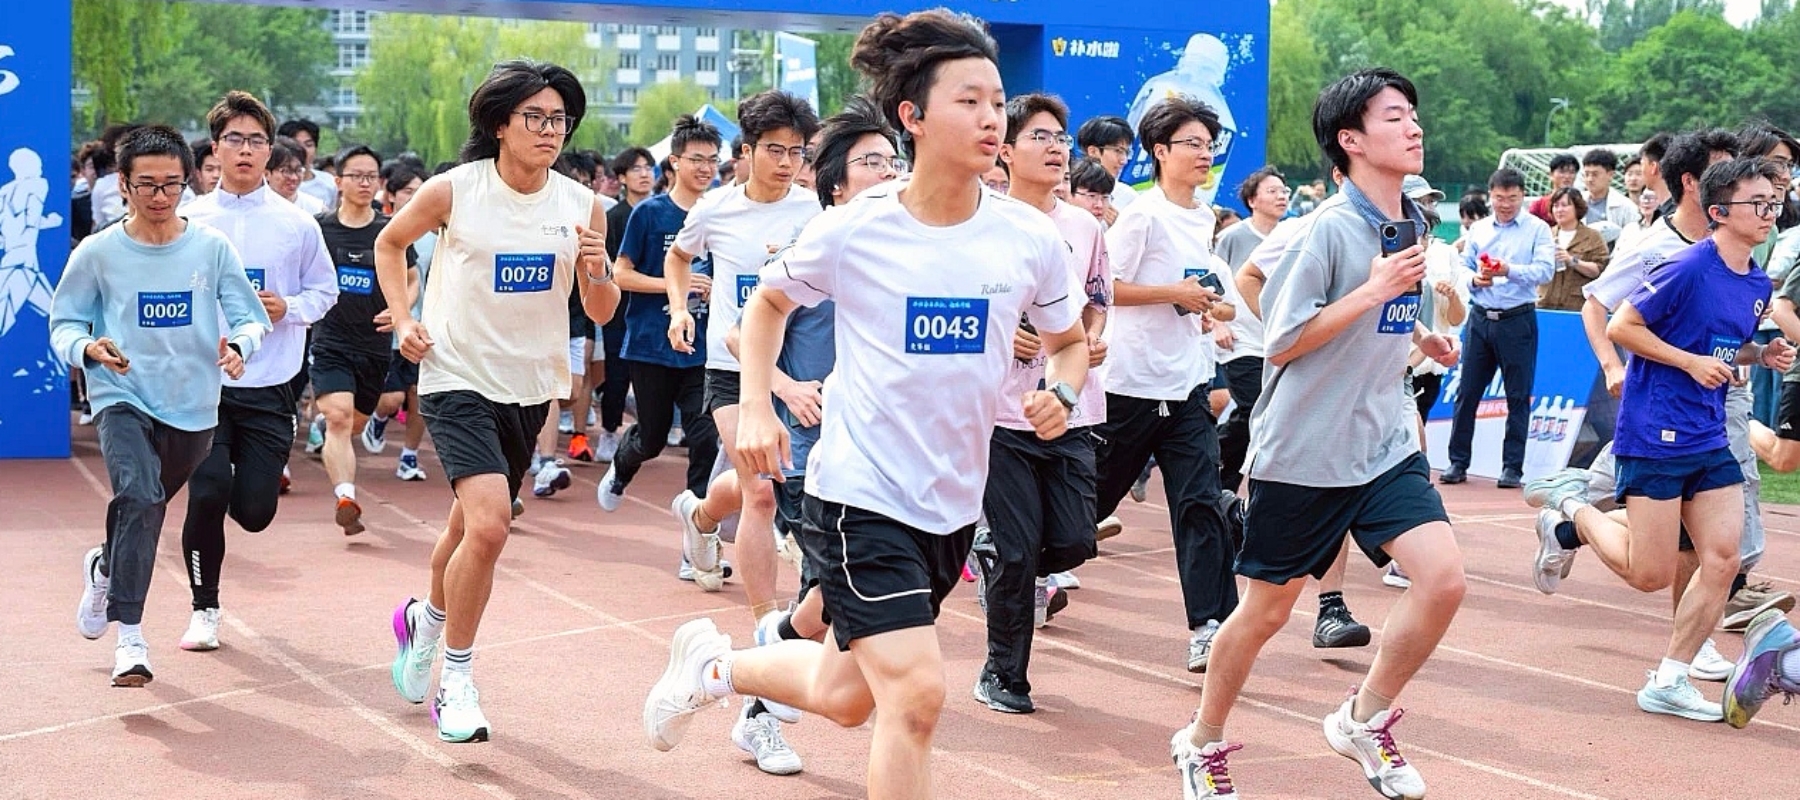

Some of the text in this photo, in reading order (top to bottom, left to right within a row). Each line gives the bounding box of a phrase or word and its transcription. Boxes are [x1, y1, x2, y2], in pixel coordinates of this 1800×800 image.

[1070, 39, 1119, 57] 补水啦
[340, 274, 371, 288] 0079
[501, 266, 549, 283] 0078
[143, 302, 188, 319] 0002
[1387, 302, 1418, 323] 0082
[913, 315, 979, 340] 0043
